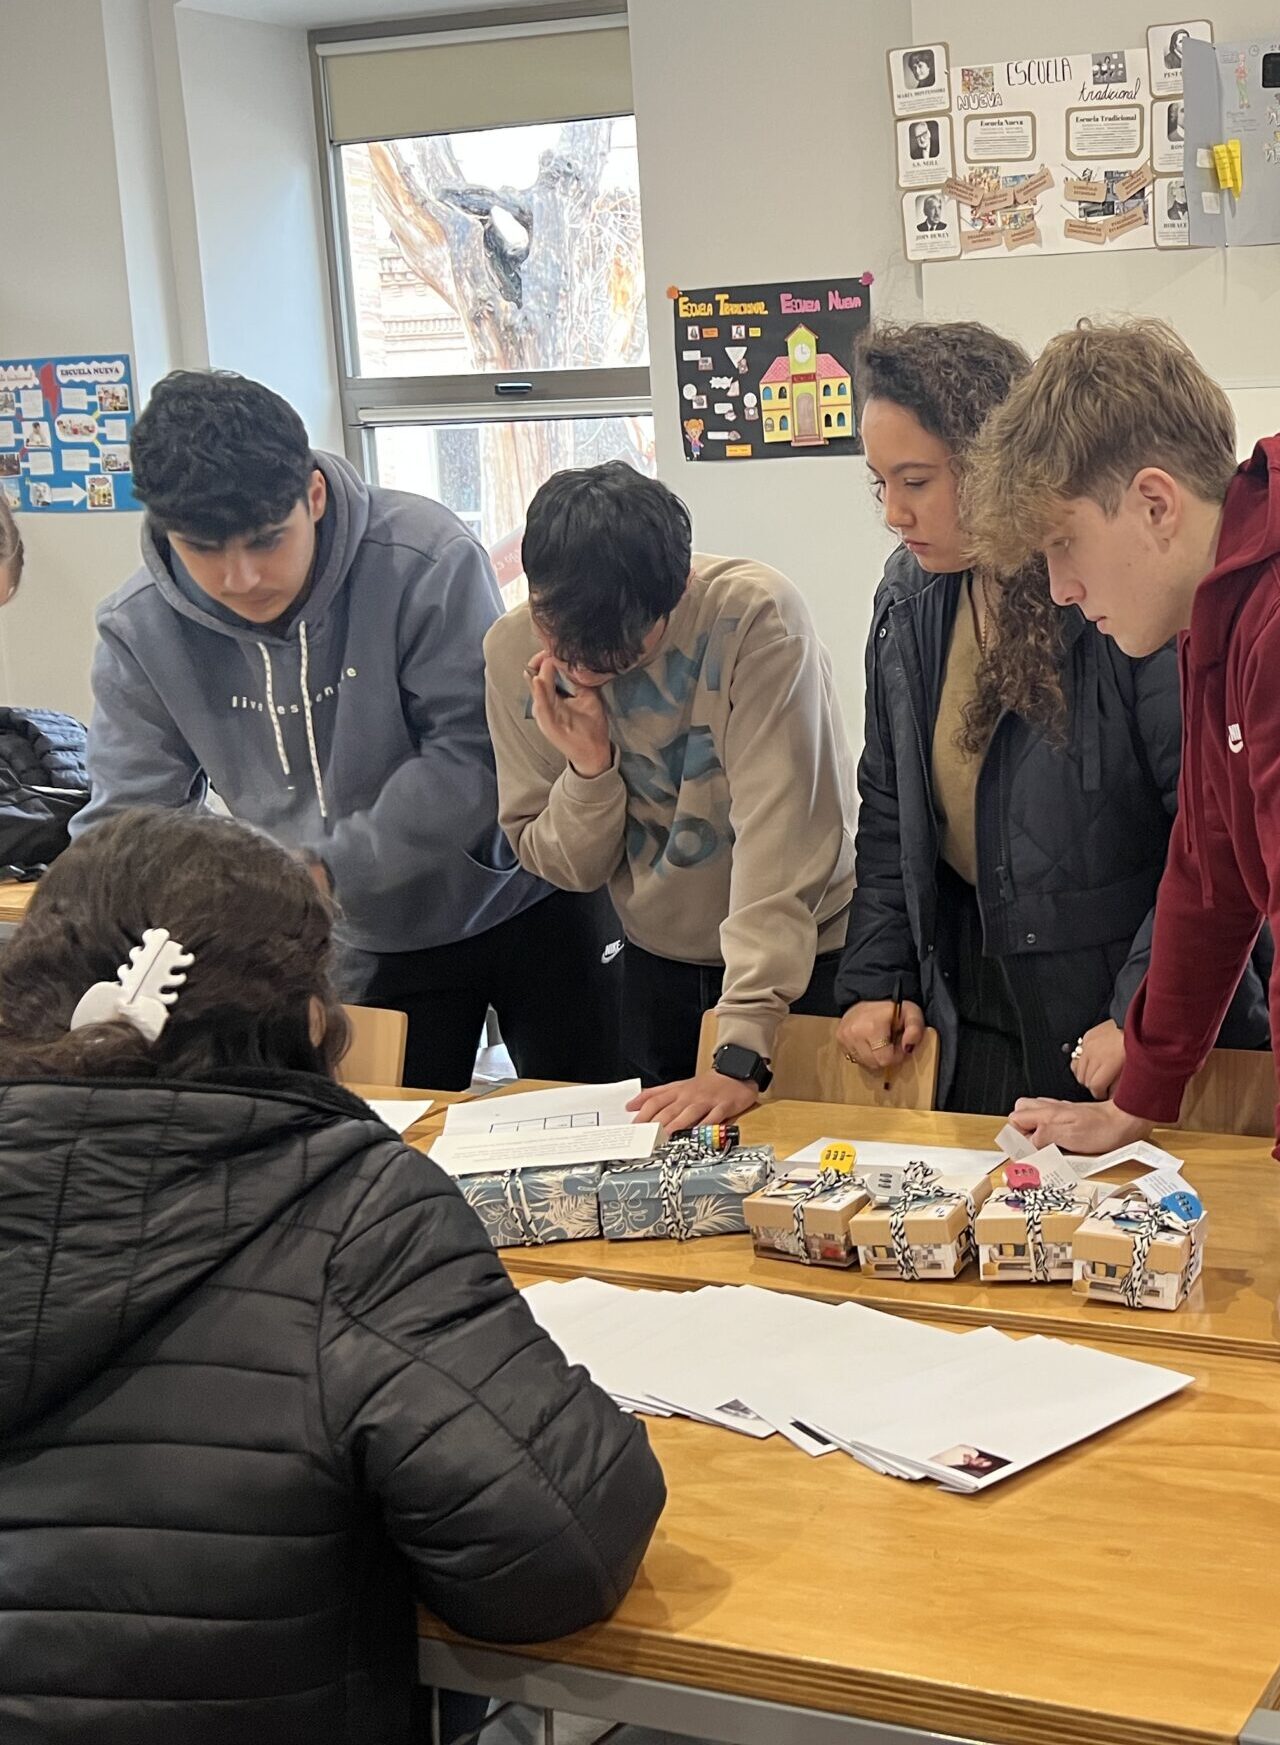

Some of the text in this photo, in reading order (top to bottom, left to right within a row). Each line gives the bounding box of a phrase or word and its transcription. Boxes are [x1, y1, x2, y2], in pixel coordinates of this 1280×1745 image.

[1006, 57, 1073, 87] ESCUELA
[1078, 77, 1142, 102] tradicional
[956, 92, 1003, 111] NUEVA
[605, 939, 621, 957] NIKE
